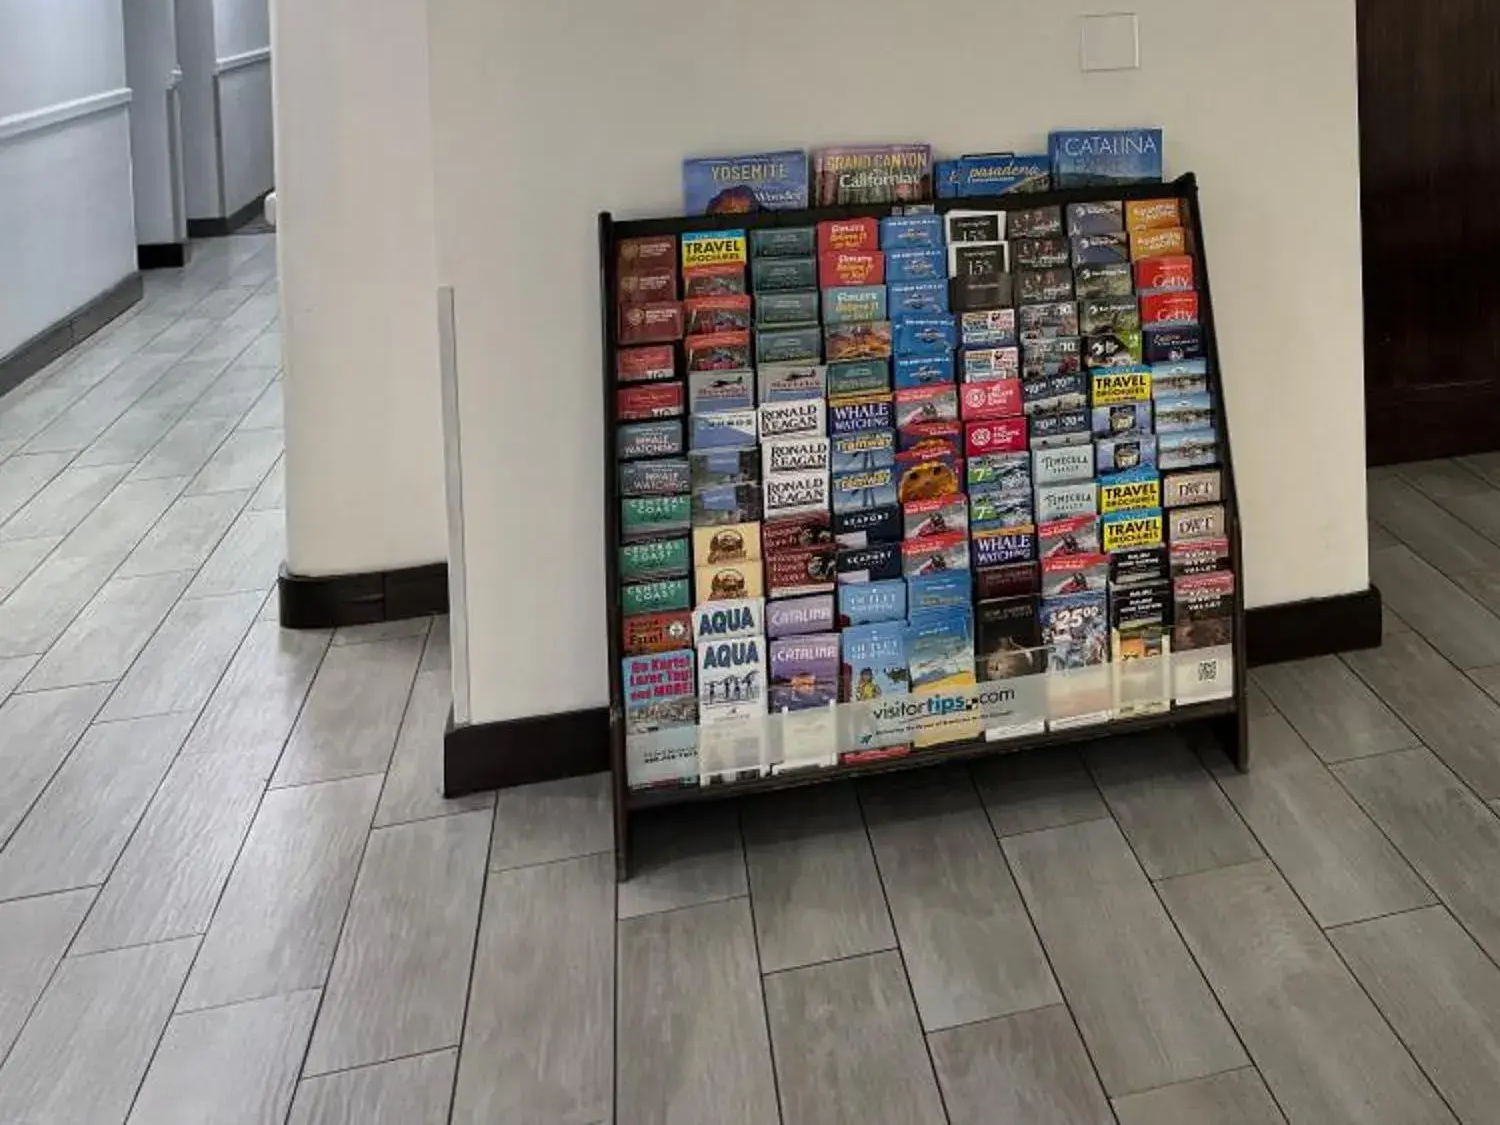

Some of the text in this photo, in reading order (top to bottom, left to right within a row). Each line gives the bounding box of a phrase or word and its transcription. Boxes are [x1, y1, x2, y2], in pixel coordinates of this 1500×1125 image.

[1065, 135, 1158, 156] CATALINA
[827, 152, 927, 171] GRAND CANYON
[711, 163, 787, 181] YOSEMITE
[686, 240, 741, 254] TRAVEL
[1096, 375, 1147, 389] TRAVEL
[762, 404, 817, 424] RONALD
[835, 403, 889, 420] WHALE
[762, 415, 817, 434] REAGAN
[835, 418, 889, 430] WATCHING
[771, 443, 827, 458] RONALD
[836, 437, 892, 452] Tramway
[770, 454, 827, 468] REAGAN
[768, 478, 823, 493] RONALD
[836, 470, 891, 488] Tramway
[767, 489, 824, 505] REAGAN
[1106, 483, 1157, 500] TRAVEL
[631, 496, 688, 508] CENTRAL
[638, 505, 677, 515] COAST
[1108, 518, 1160, 536] TRAVEL
[623, 542, 681, 555] CENTRAL
[978, 534, 1031, 551] WHALE
[632, 550, 672, 563] COAST
[977, 548, 1031, 564] WATCHING
[627, 581, 682, 596] CENTRAL
[635, 589, 675, 603] COAST
[699, 606, 755, 636] AQUA
[771, 607, 831, 626] CATALINA
[703, 640, 759, 670] AQUA
[775, 645, 837, 662] CATALINA
[653, 682, 693, 697] MORE!
